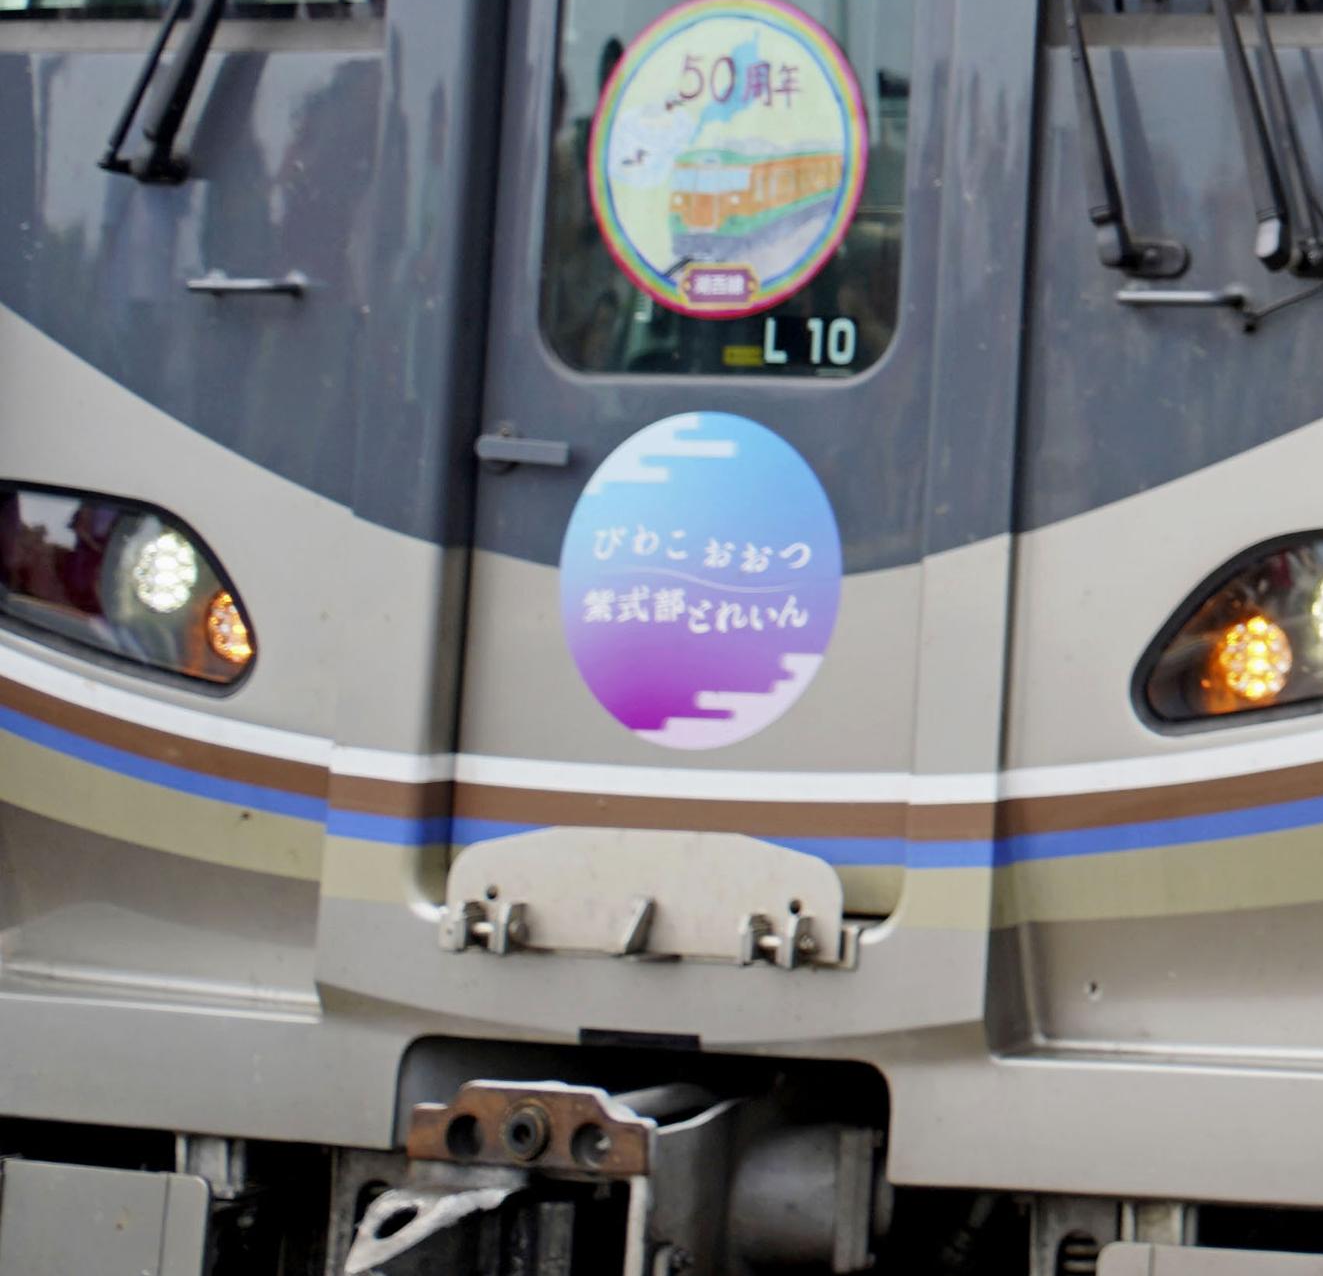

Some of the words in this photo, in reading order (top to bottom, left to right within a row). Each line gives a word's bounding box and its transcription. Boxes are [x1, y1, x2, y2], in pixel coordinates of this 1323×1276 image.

[679, 52, 804, 108] 50周年
[763, 316, 788, 364] L
[806, 316, 856, 365] 10
[593, 524, 812, 574] びわこおおつ
[583, 585, 808, 634] 紫式部とれいん
